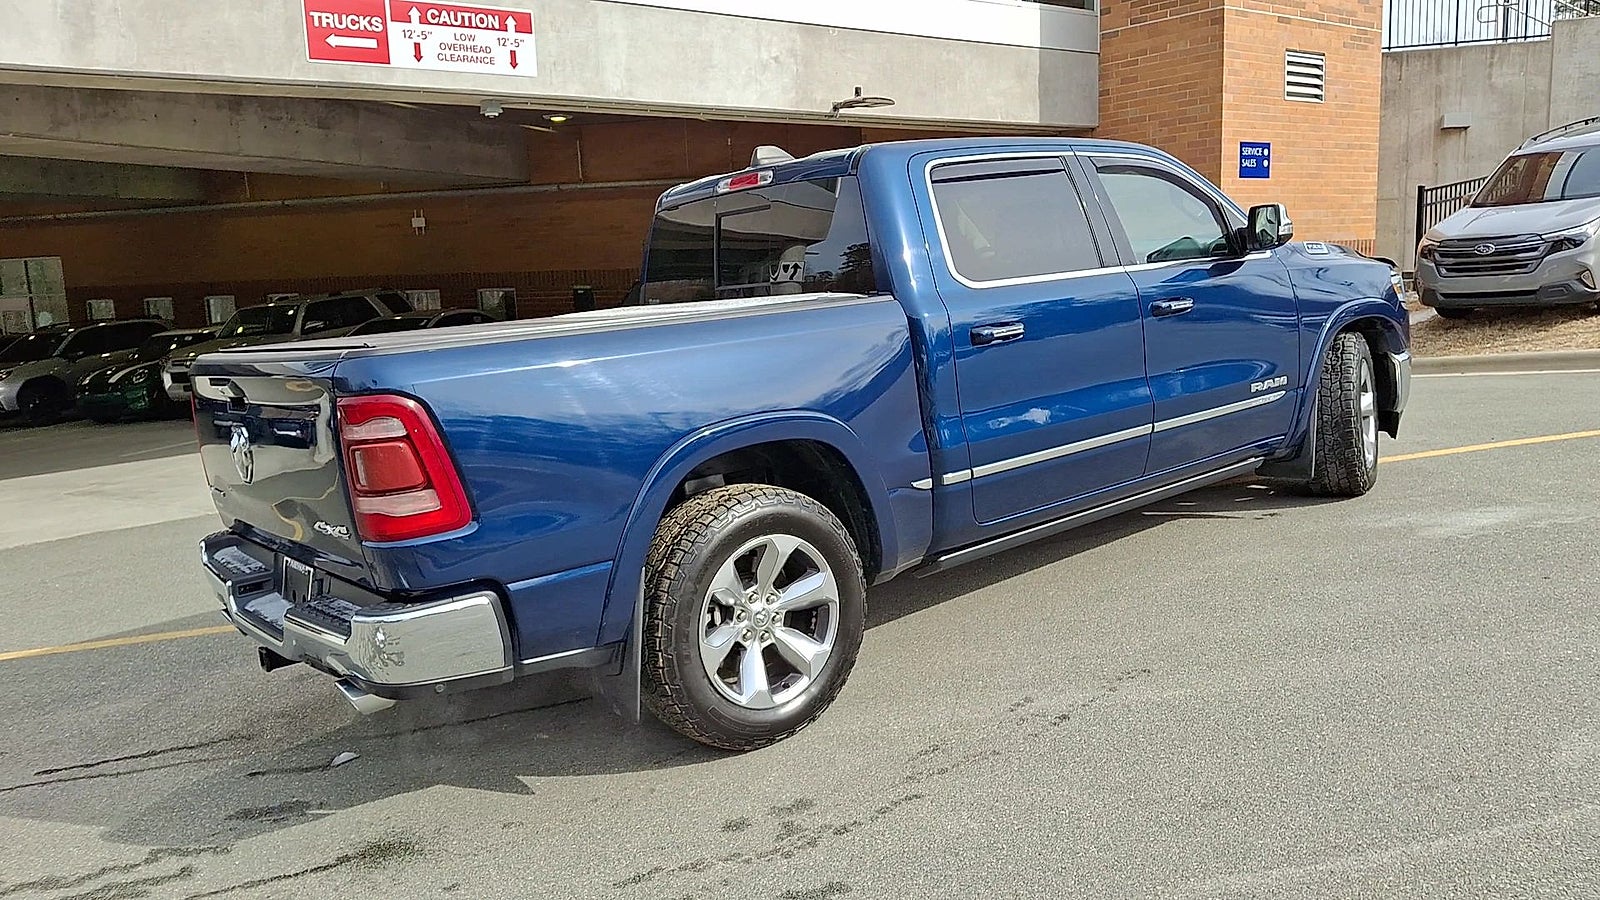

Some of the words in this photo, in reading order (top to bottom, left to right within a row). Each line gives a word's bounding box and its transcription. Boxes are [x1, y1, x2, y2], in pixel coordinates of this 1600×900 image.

[309, 12, 383, 32] TRUCKS
[426, 9, 499, 29] CAUTION
[454, 33, 476, 42] LOW
[439, 42, 492, 54] OVERHEAD
[437, 53, 496, 66] CLEARANCE
[1242, 147, 1263, 156] SERVICE
[1241, 158, 1257, 167] SALES
[1251, 376, 1287, 393] RAM
